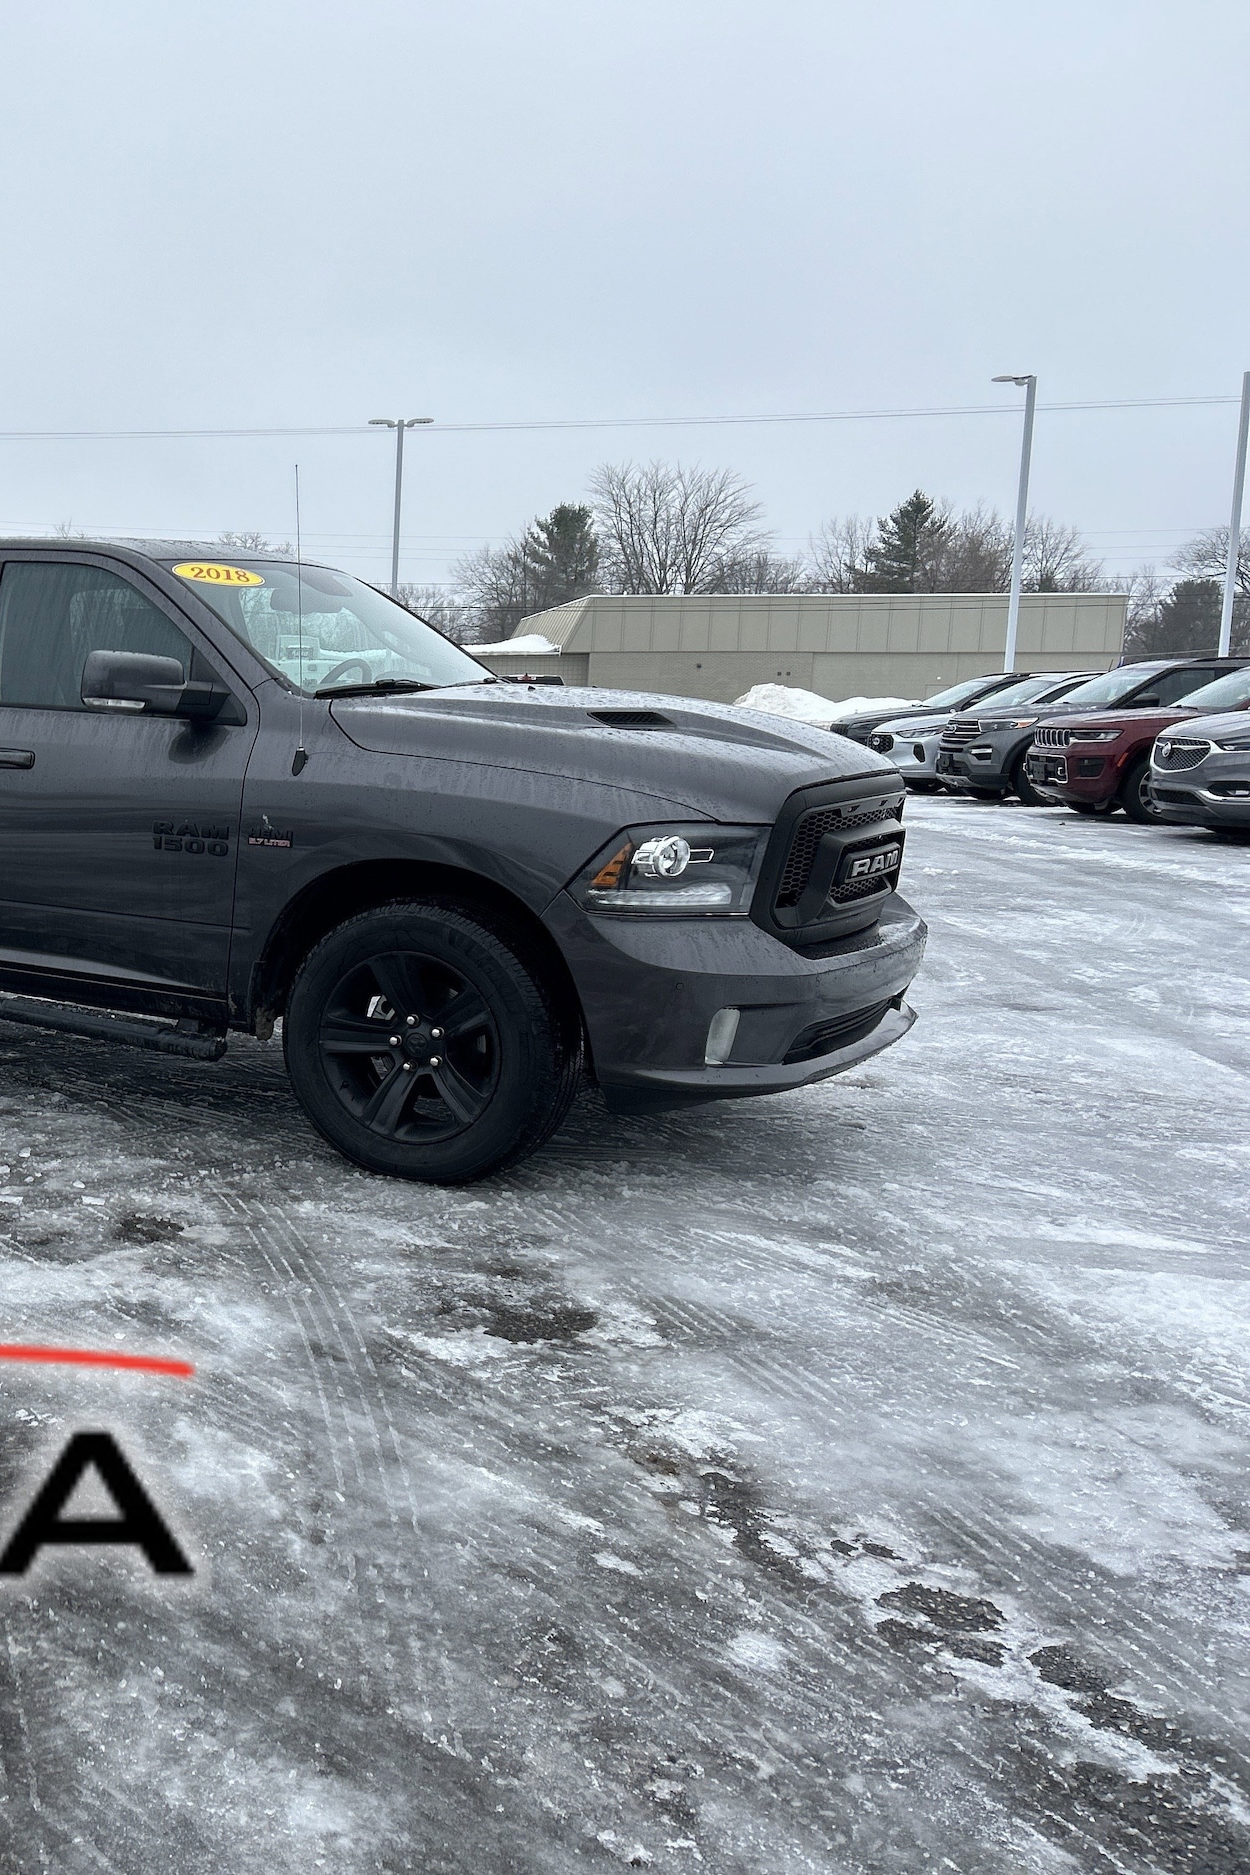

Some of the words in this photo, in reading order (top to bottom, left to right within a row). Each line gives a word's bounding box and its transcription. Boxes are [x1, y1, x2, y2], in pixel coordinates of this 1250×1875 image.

[190, 566, 250, 583] 2018
[153, 820, 230, 840] RAM
[153, 836, 229, 857] 1500
[851, 850, 899, 877] RAM
